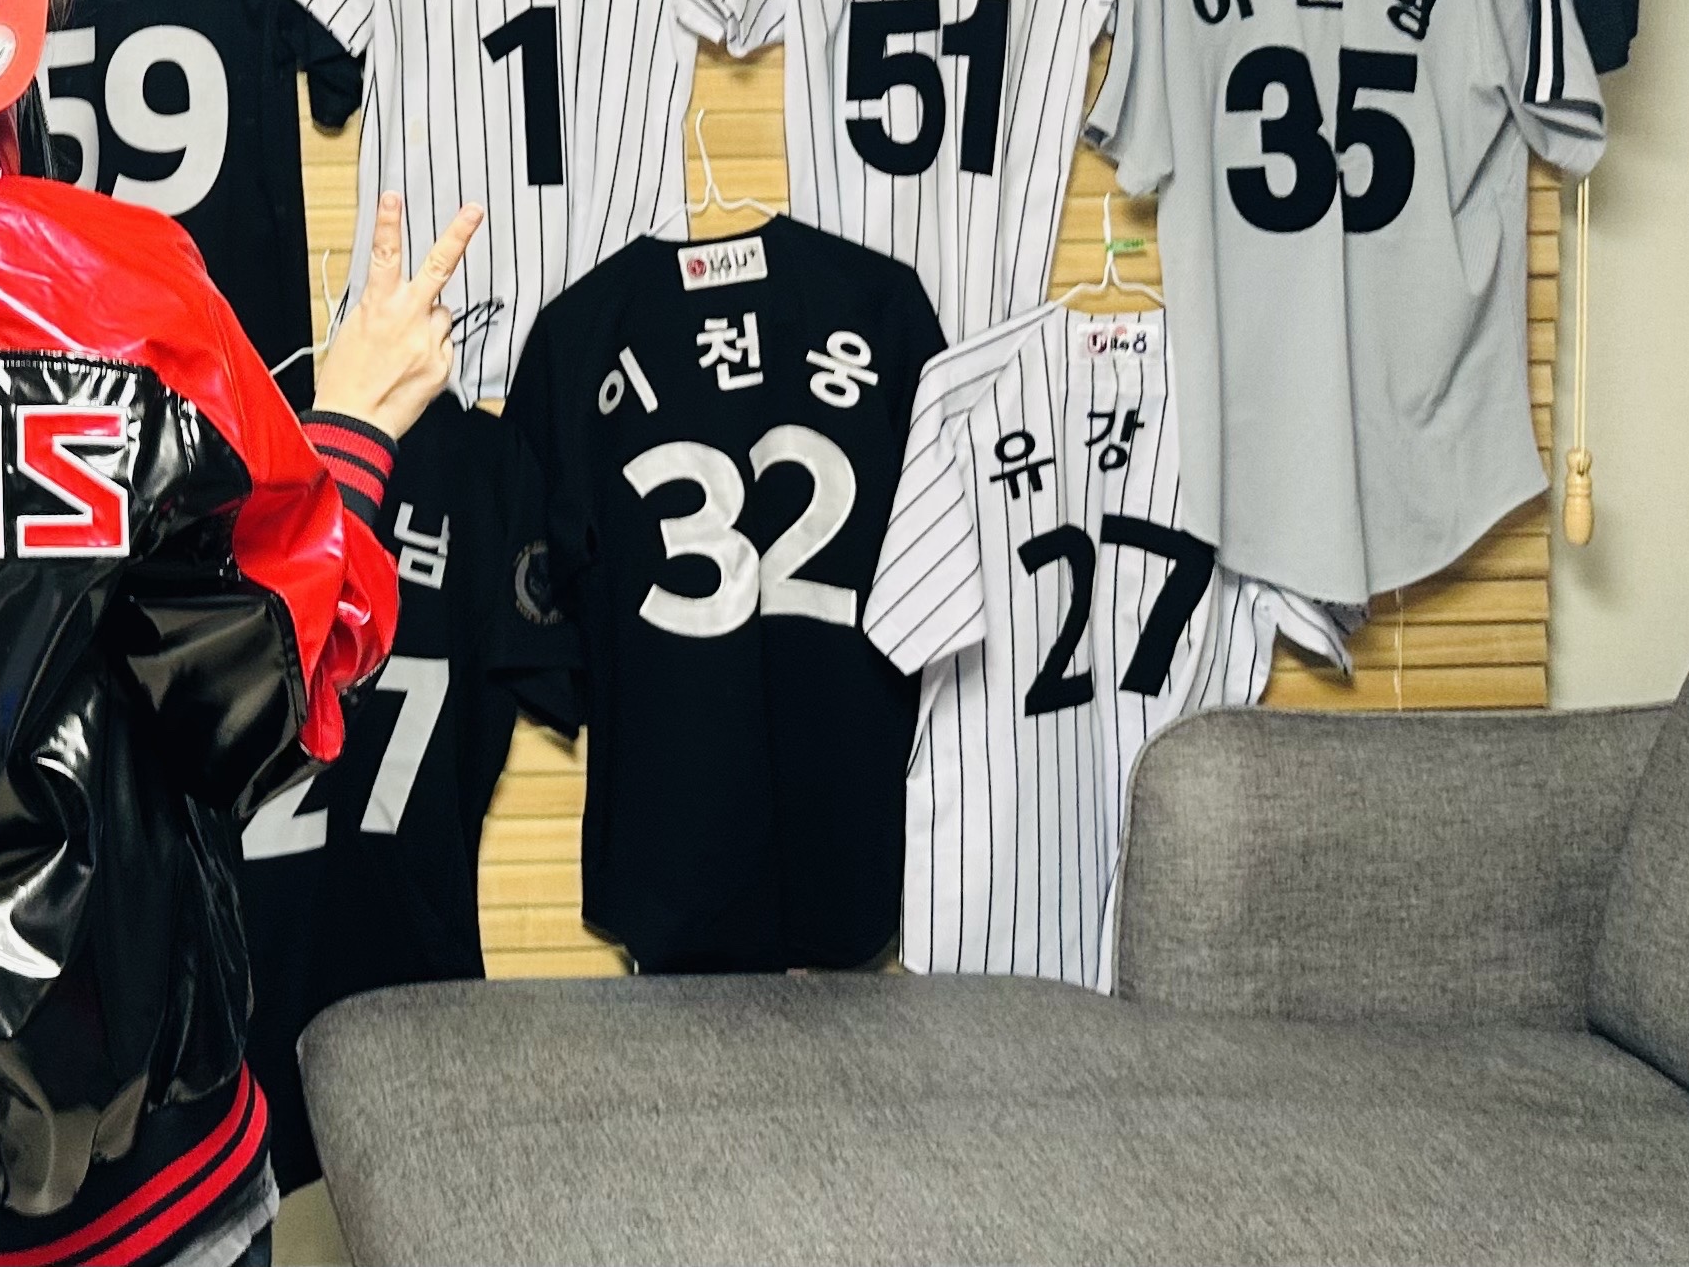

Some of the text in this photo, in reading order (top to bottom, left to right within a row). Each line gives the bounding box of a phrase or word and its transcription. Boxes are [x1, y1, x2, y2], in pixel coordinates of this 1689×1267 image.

[35, 24, 229, 218] 59
[482, 5, 564, 186] 1
[1225, 44, 1419, 233] 35
[597, 311, 879, 415] 이천웅
[622, 423, 858, 639] 32
[1016, 512, 1219, 717] 27
